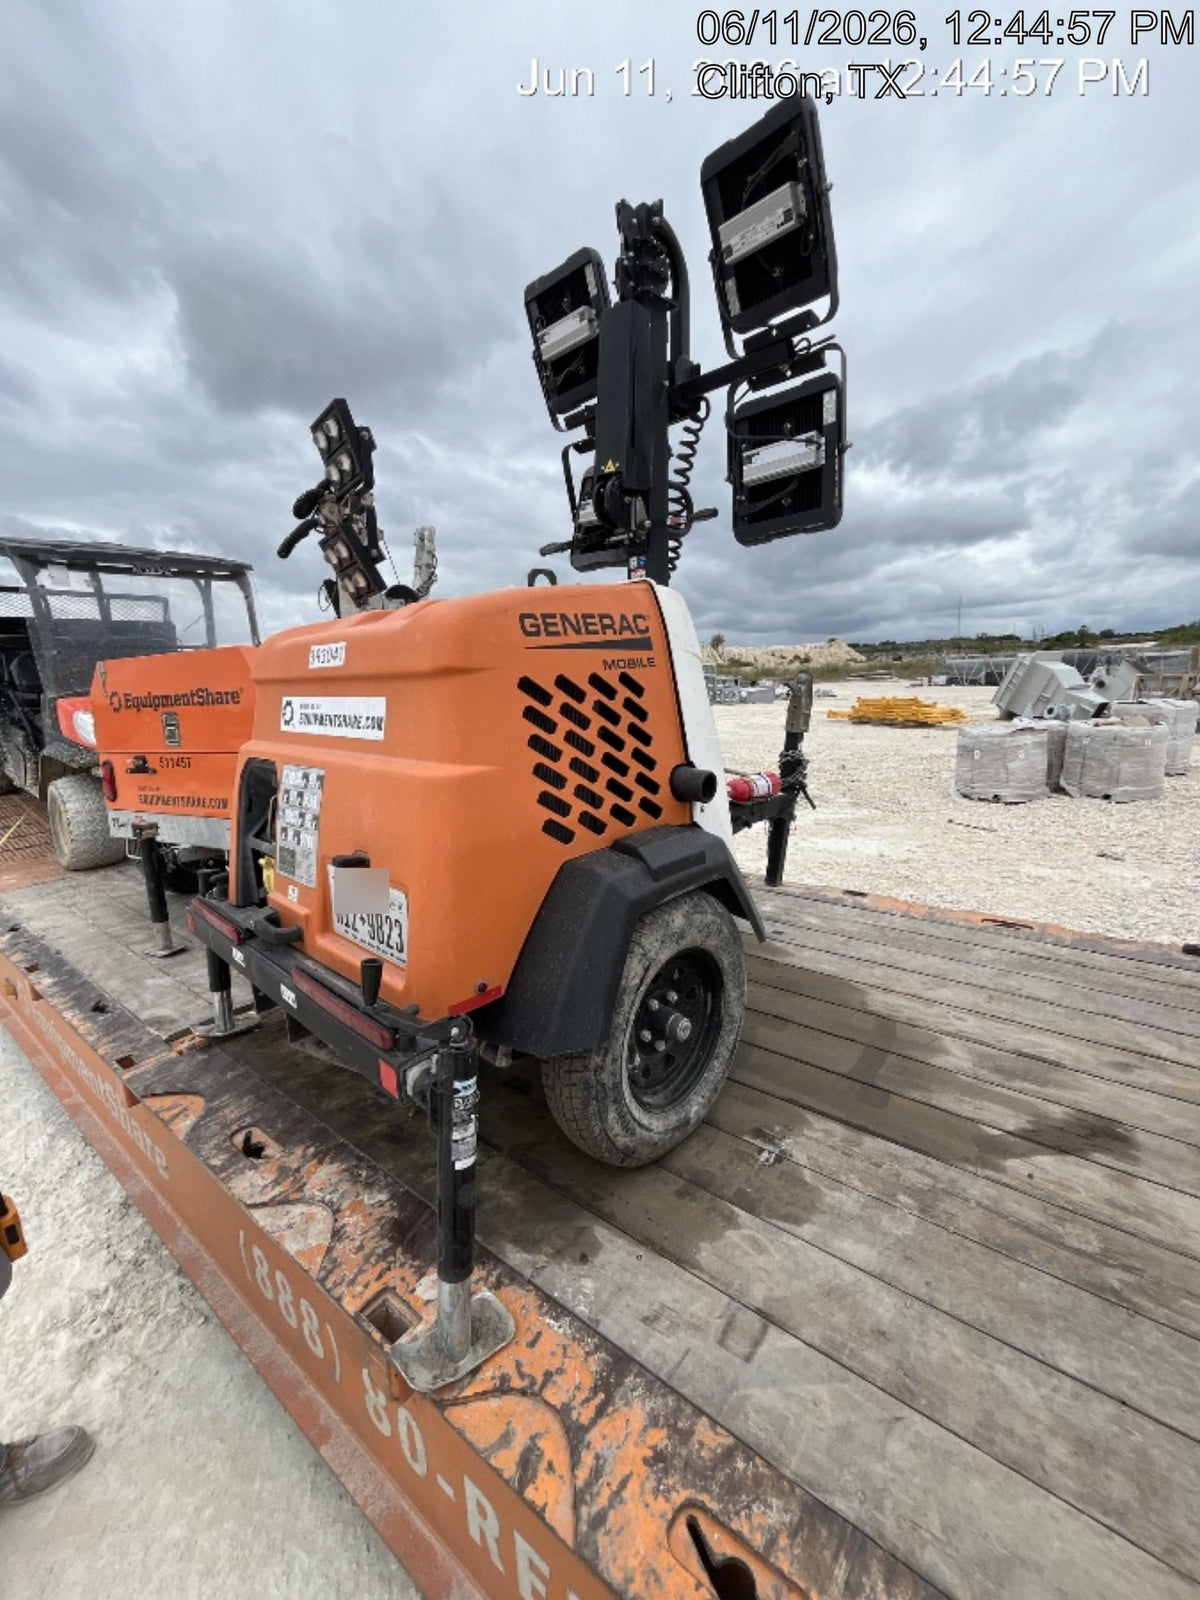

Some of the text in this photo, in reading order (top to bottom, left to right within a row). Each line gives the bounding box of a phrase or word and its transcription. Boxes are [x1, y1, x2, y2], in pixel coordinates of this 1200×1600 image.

[519, 612, 650, 637] GENERAC
[602, 657, 656, 671] MOBILE
[123, 687, 241, 713] EquipmentShare
[239, 1229, 581, 1600] (888) 80-RE
